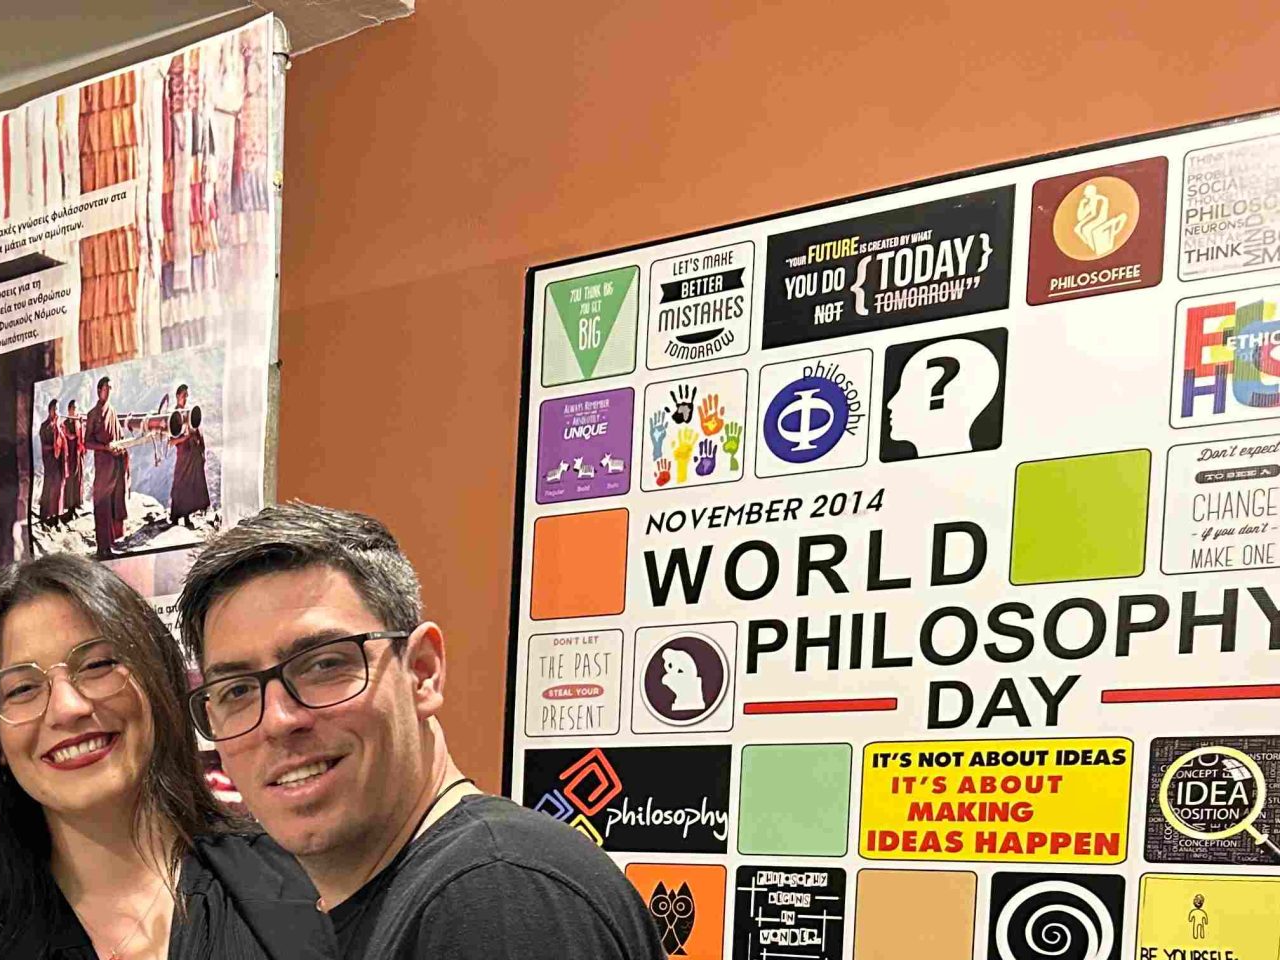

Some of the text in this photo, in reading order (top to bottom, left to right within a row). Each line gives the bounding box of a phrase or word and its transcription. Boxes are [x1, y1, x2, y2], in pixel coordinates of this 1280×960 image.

[18, 214, 49, 234] γνώσεις
[51, 196, 109, 221] φυλάσσονταν
[111, 190, 127, 202] στα
[5, 239, 27, 253] μάτια
[29, 234, 43, 245] των
[807, 229, 933, 264] FUTURE IS CREATED BY WHAT
[1184, 242, 1242, 264] THINK
[673, 250, 734, 276] LET'S MAKE
[18, 283, 30, 295] για
[681, 274, 723, 298] BETTER
[785, 269, 818, 300] YOU
[822, 267, 845, 294] DO
[1050, 264, 1141, 291] PHILOSOFFEE
[28, 288, 71, 305] ανθρώπου
[658, 295, 744, 333] MISTAKES
[814, 301, 844, 325] NOT
[578, 315, 601, 351] BIG
[664, 330, 735, 360] TOMORROW
[803, 360, 866, 436] philosophy
[564, 422, 609, 440] UNIQUE
[1197, 445, 1238, 462] Don't
[646, 488, 885, 535] NOVEMBER 2014
[1192, 487, 1280, 522] CHANGE
[1201, 523, 1269, 541] if you don't
[644, 521, 988, 608] WORLD
[1190, 543, 1276, 569] MAKE ONE
[582, 636, 599, 645] LET
[746, 587, 1280, 674] PHILOSOPHY
[539, 652, 611, 679] THE PAST
[548, 687, 599, 697] STEAL YOUR
[927, 674, 1082, 730] DAY
[542, 704, 605, 731] PRESENT
[872, 748, 1127, 768] IT'S NOT ABOUT IDEAS
[891, 775, 1063, 795] IT'S ABOUT
[1177, 780, 1249, 806] IDEA
[605, 796, 730, 841] philosophy
[907, 801, 1034, 823] MAKING
[867, 830, 1120, 856] IDEAS HAPPEN
[1179, 839, 1237, 848] CONCEPTION
[757, 871, 828, 887] PHILOSOPHY
[769, 893, 810, 907] BEGINS
[781, 911, 795, 925] IN
